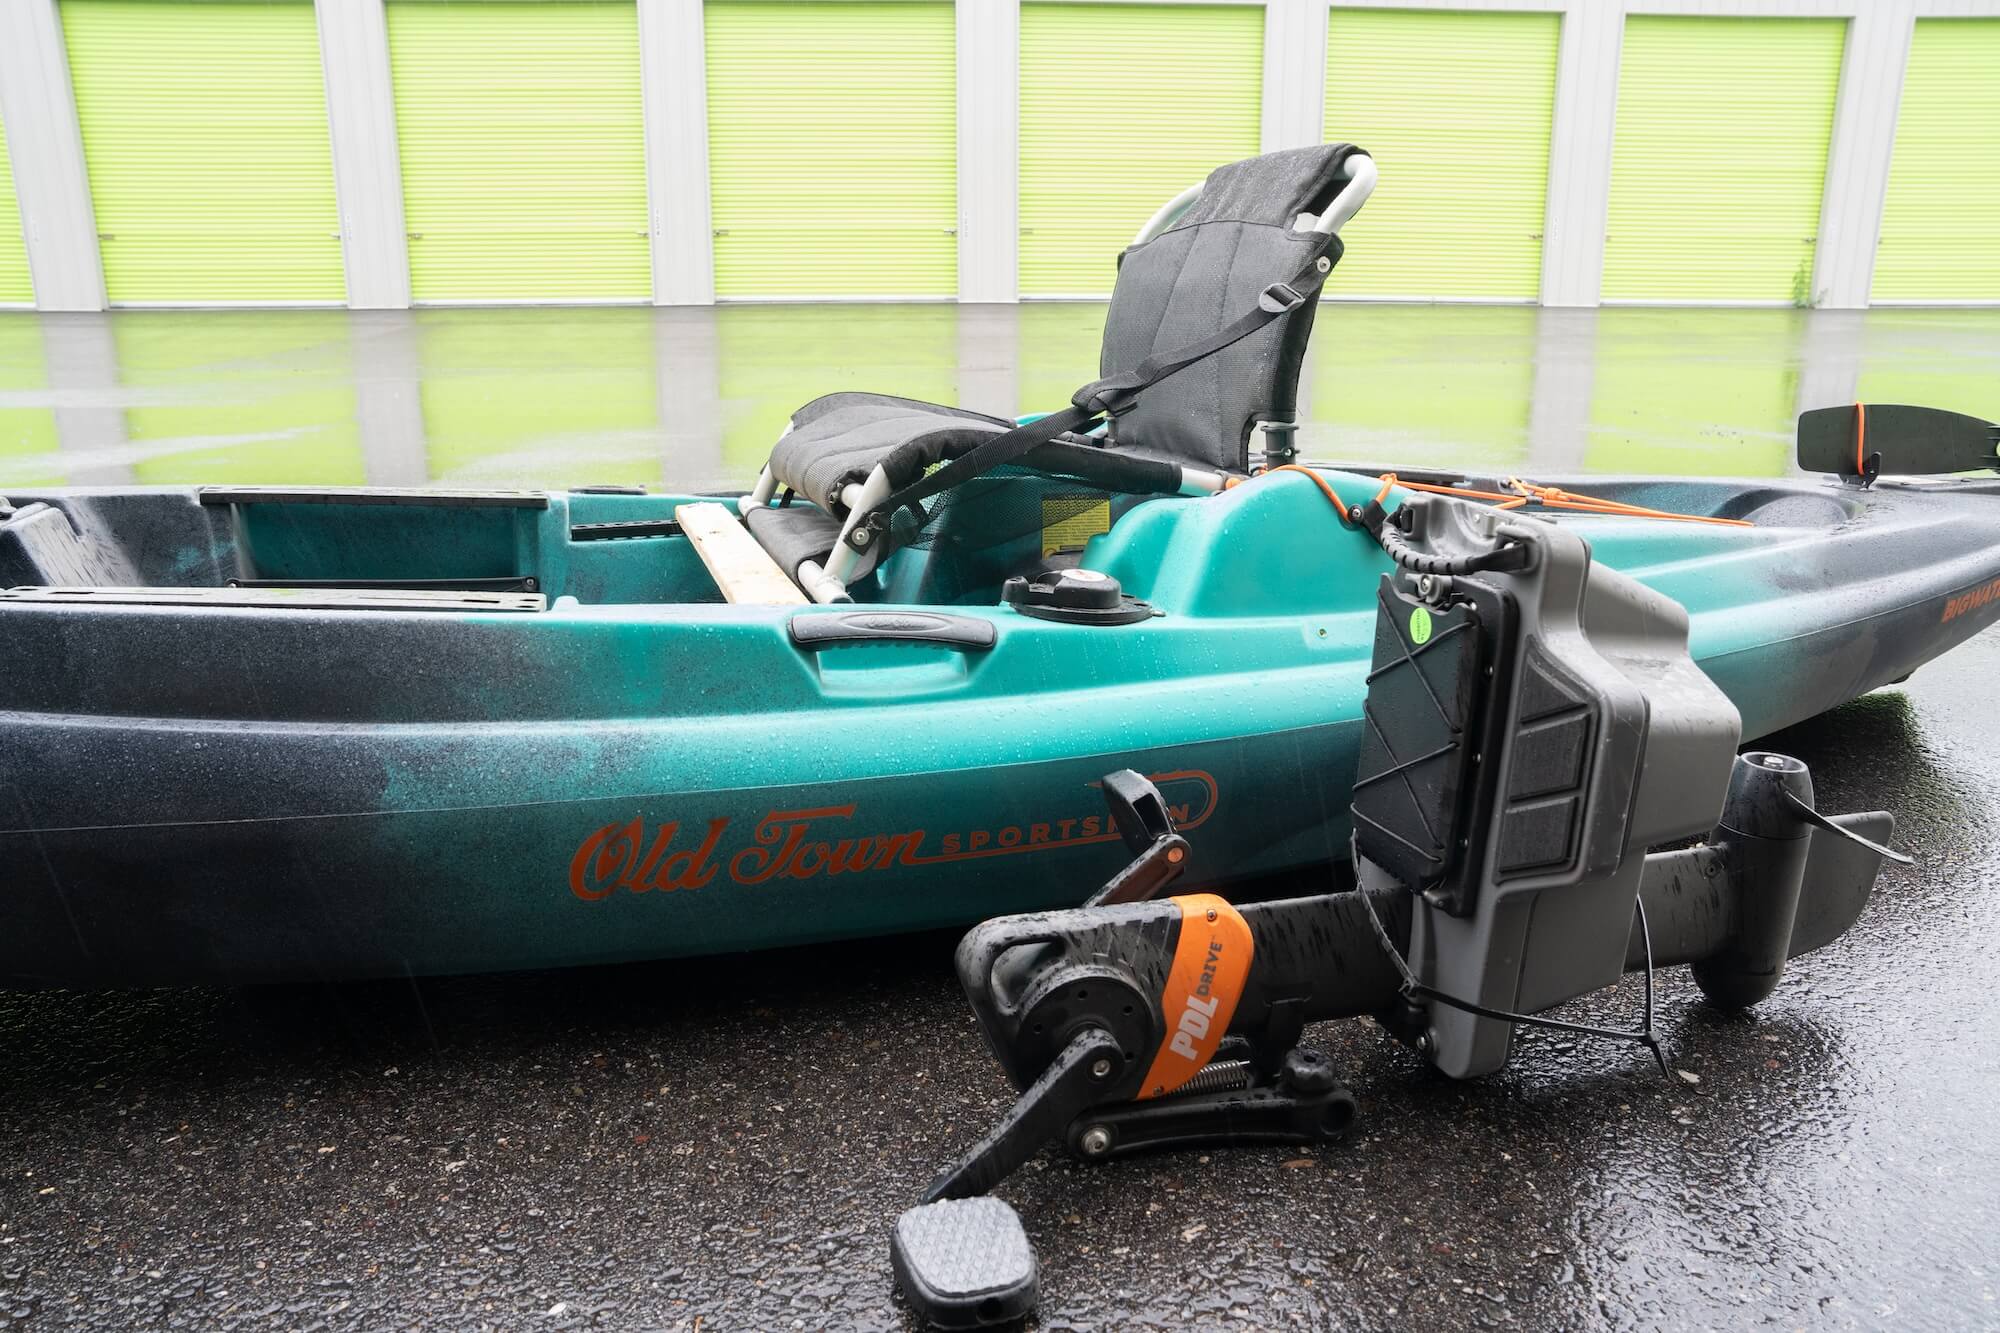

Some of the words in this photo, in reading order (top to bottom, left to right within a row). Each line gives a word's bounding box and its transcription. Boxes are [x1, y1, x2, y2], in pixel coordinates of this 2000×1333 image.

[568, 815, 732, 901] Old
[729, 803, 930, 885] Town
[942, 803, 1190, 854] SPORTSN
[1169, 994, 1219, 1061] PDL
[1196, 942, 1223, 996] DRIVE
